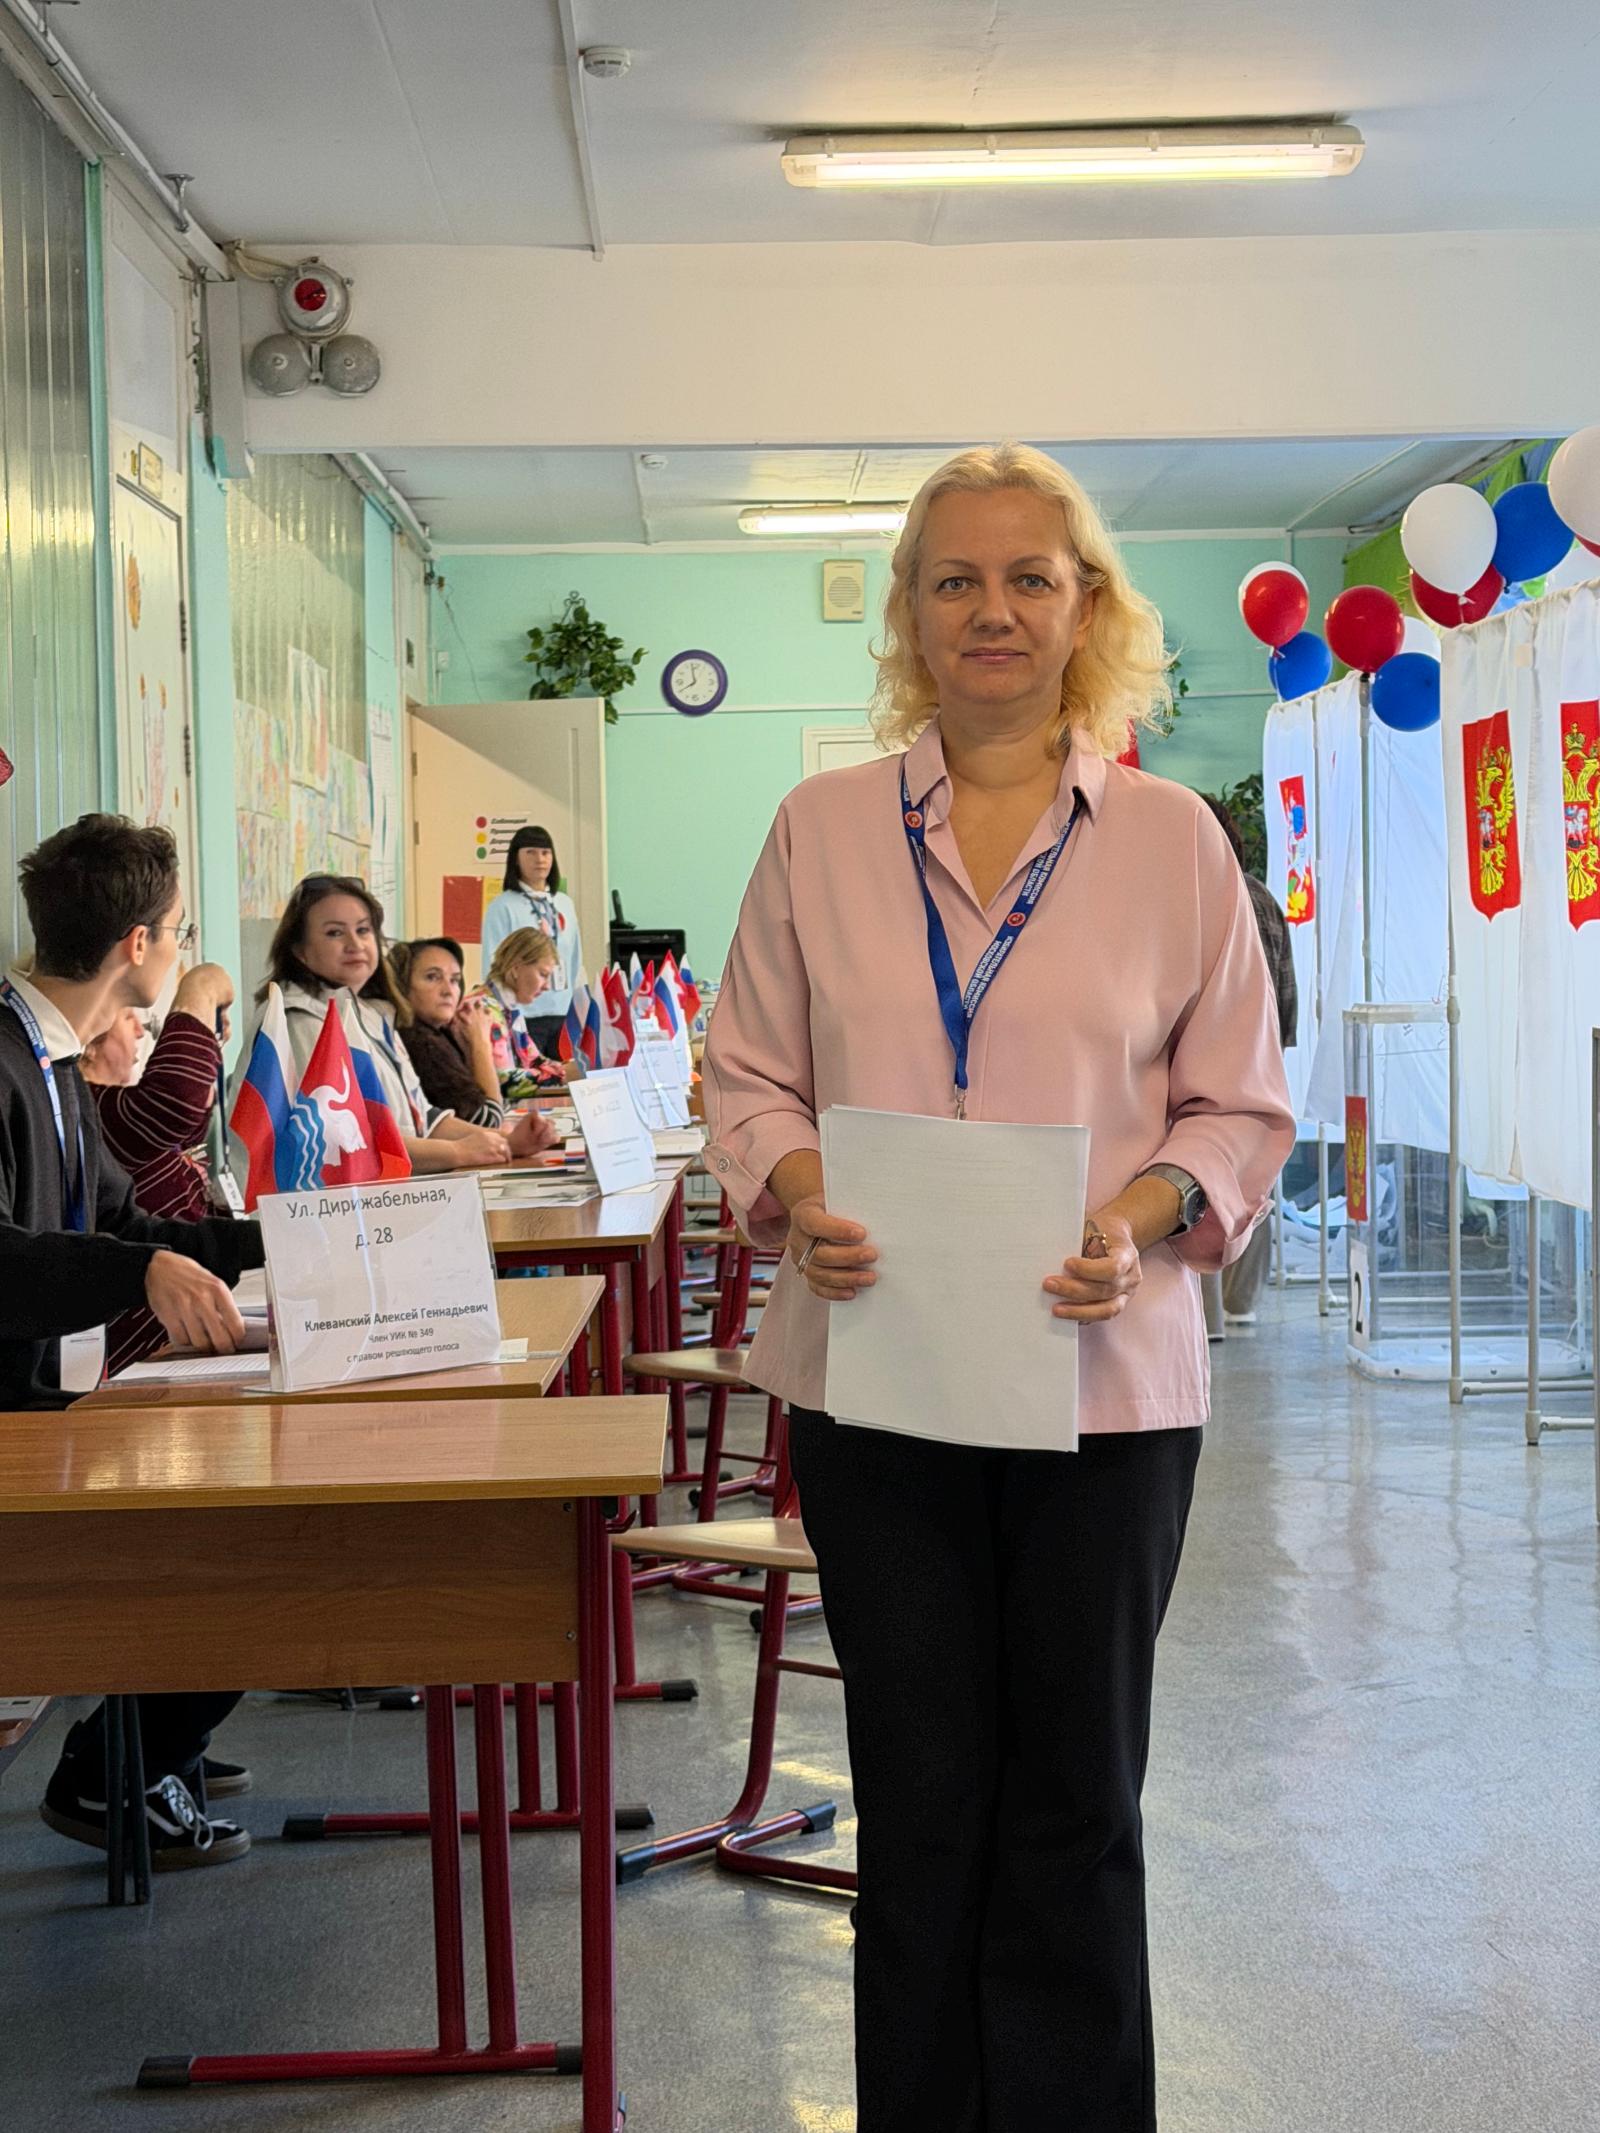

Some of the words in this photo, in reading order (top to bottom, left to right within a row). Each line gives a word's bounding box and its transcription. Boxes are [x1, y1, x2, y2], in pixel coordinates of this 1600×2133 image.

[286, 1202, 314, 1219] Ул.
[318, 1188, 452, 1219] Дирижабельная,
[355, 1234, 371, 1251] д.
[374, 1227, 394, 1245] 28
[1354, 1271, 1363, 1335] 2
[304, 1313, 371, 1332] Клеванский
[373, 1308, 419, 1325] Алексей
[420, 1303, 489, 1319] Геннадьевич
[368, 1334, 389, 1343] Член
[389, 1331, 407, 1342] УИК
[419, 1327, 434, 1338] 349
[433, 1342, 460, 1354] голоса
